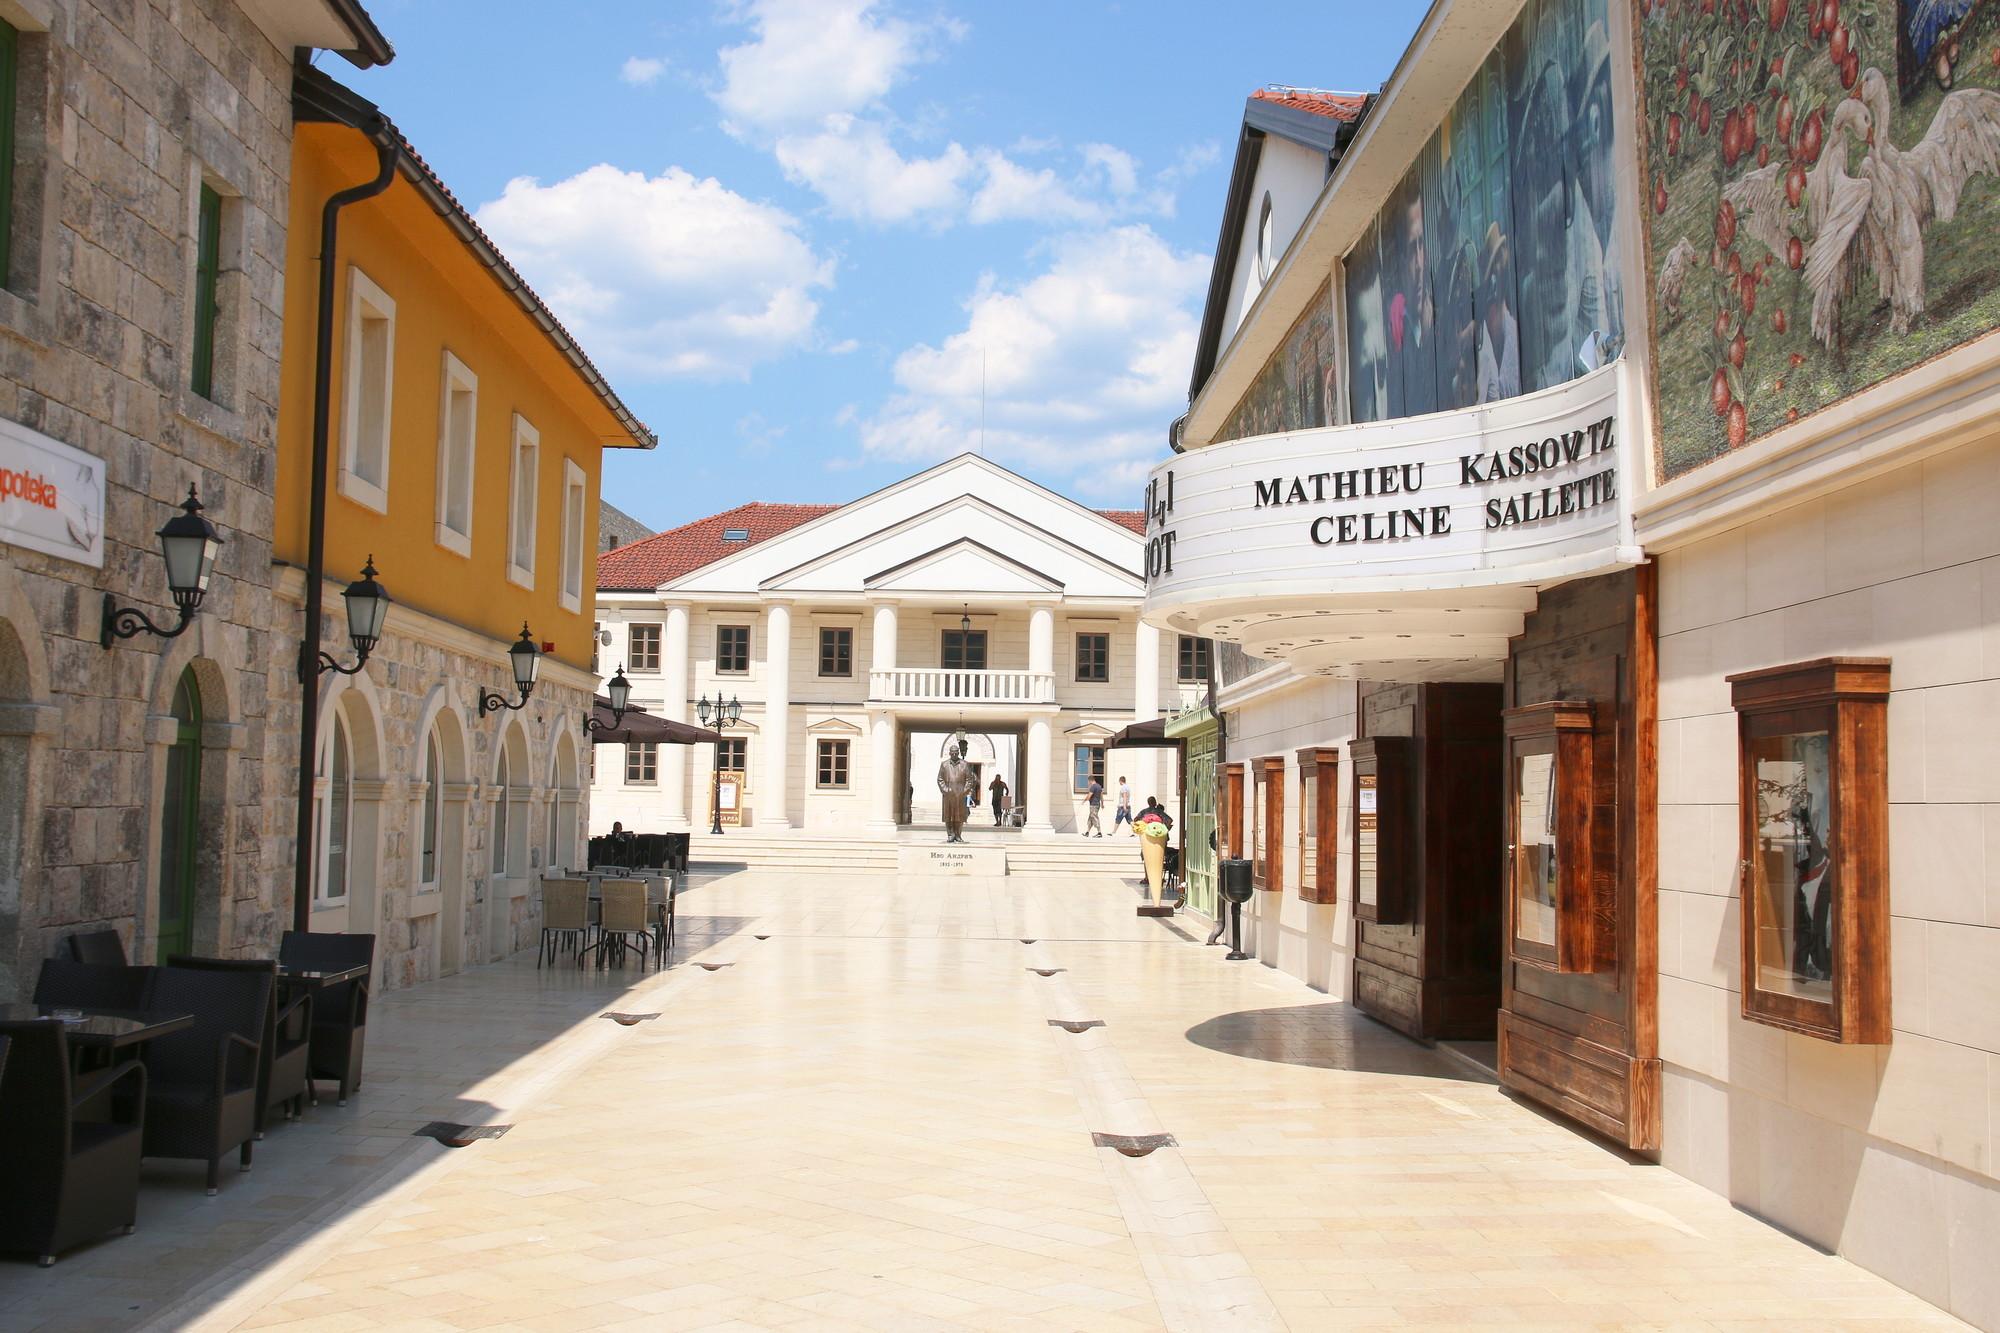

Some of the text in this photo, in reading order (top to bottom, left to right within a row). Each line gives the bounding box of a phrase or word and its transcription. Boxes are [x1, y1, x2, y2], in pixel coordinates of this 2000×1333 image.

[0, 468, 57, 510] poteka
[1254, 462, 1425, 508] MATHIEU
[1310, 468, 1616, 546] CELINE SALLETTE
